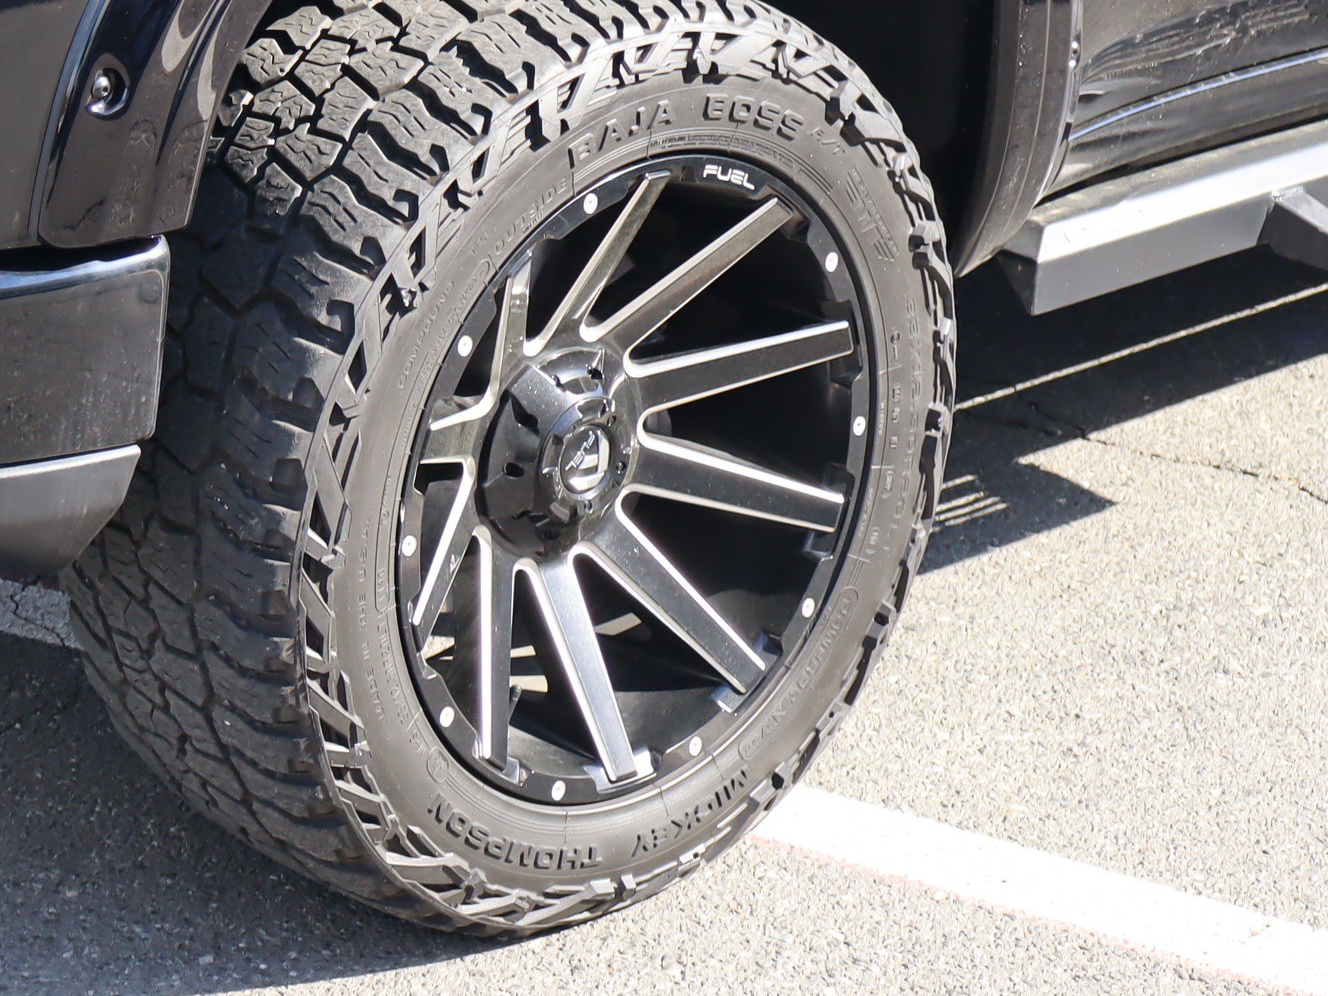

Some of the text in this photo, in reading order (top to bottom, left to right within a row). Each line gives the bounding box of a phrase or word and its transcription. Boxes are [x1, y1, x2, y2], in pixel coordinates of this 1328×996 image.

[568, 99, 677, 169] BAJA
[704, 93, 805, 141] BOSS
[702, 164, 755, 191] FUEL
[494, 180, 568, 258] OUTSIDE
[399, 280, 456, 387] COMPOUND
[565, 432, 596, 471] FUEL
[366, 667, 386, 721] MADE
[427, 764, 752, 871] MICKEY THOMPSON
